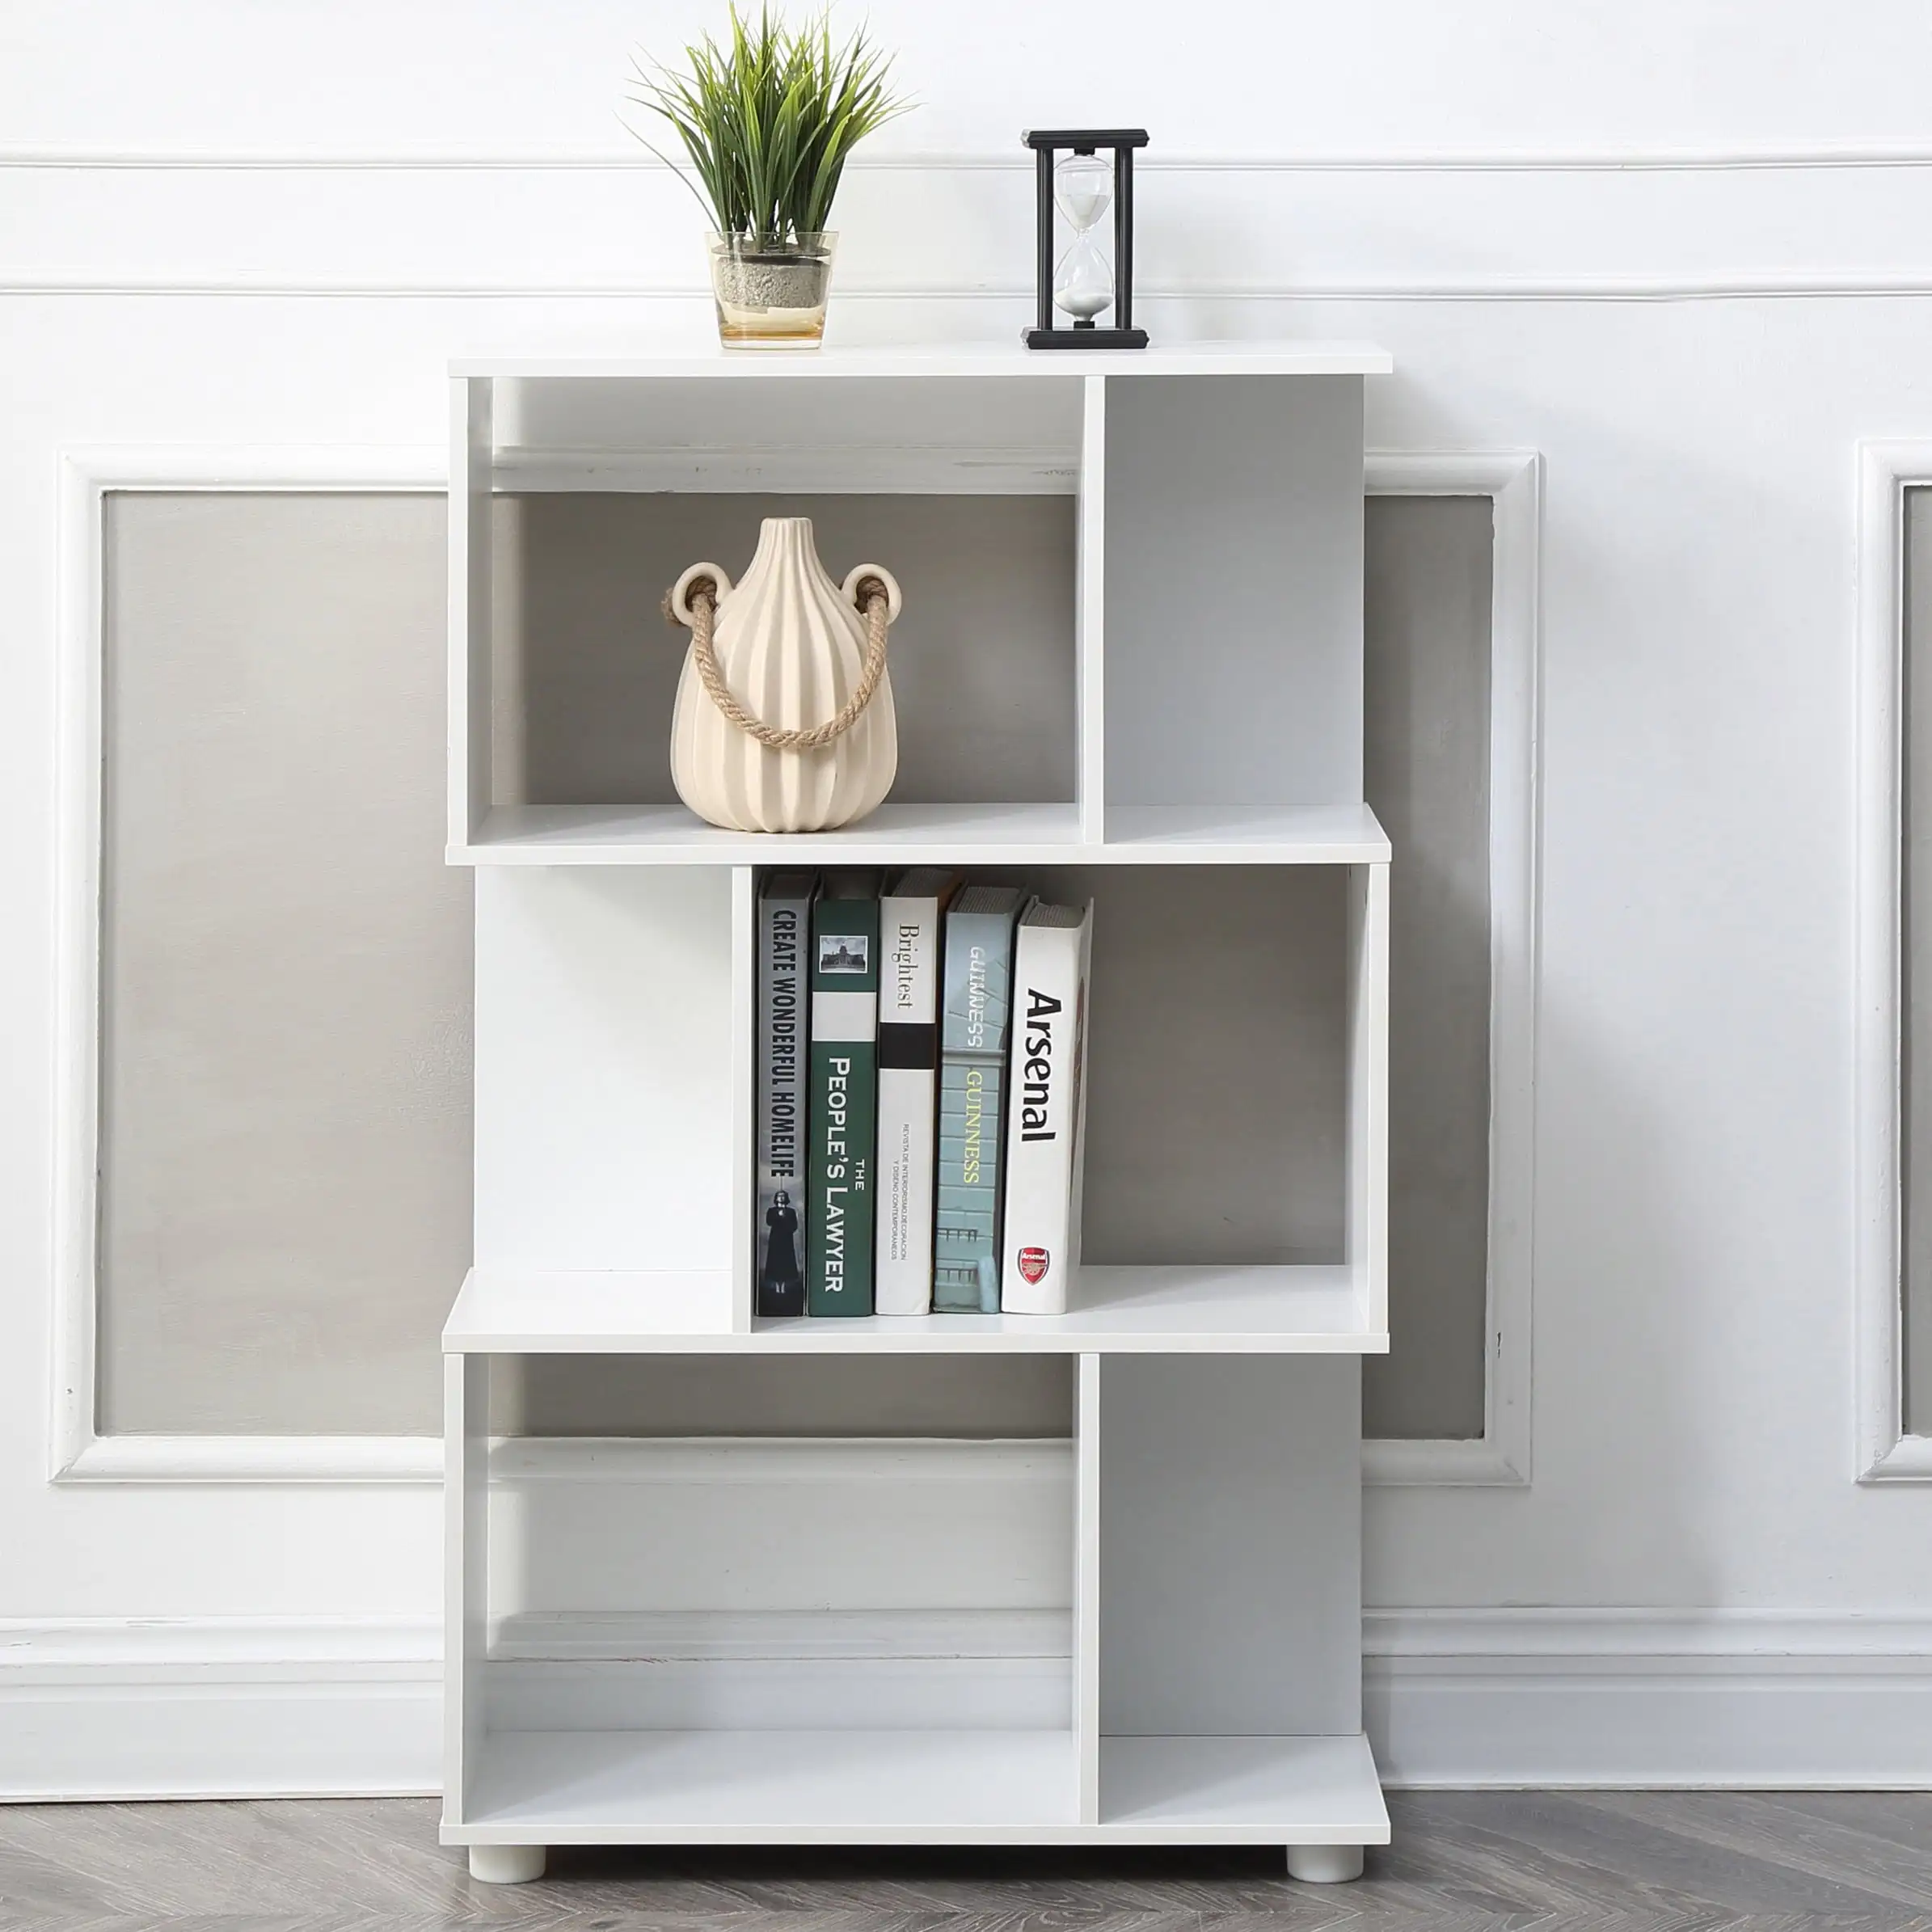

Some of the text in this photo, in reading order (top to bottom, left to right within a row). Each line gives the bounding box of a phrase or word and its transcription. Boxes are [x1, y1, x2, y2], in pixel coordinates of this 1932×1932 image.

[891, 924, 920, 1010] Brightest
[968, 947, 986, 1048] GUINNESS
[770, 909, 797, 1177] CREATE WONDERFUL HOMELIFE
[1021, 988, 1061, 1142] Arsenal
[854, 1158, 865, 1191] THE
[902, 1153, 909, 1163] DE
[963, 1071, 983, 1184] GUINNESS
[825, 1186, 848, 1293] LAWYER
